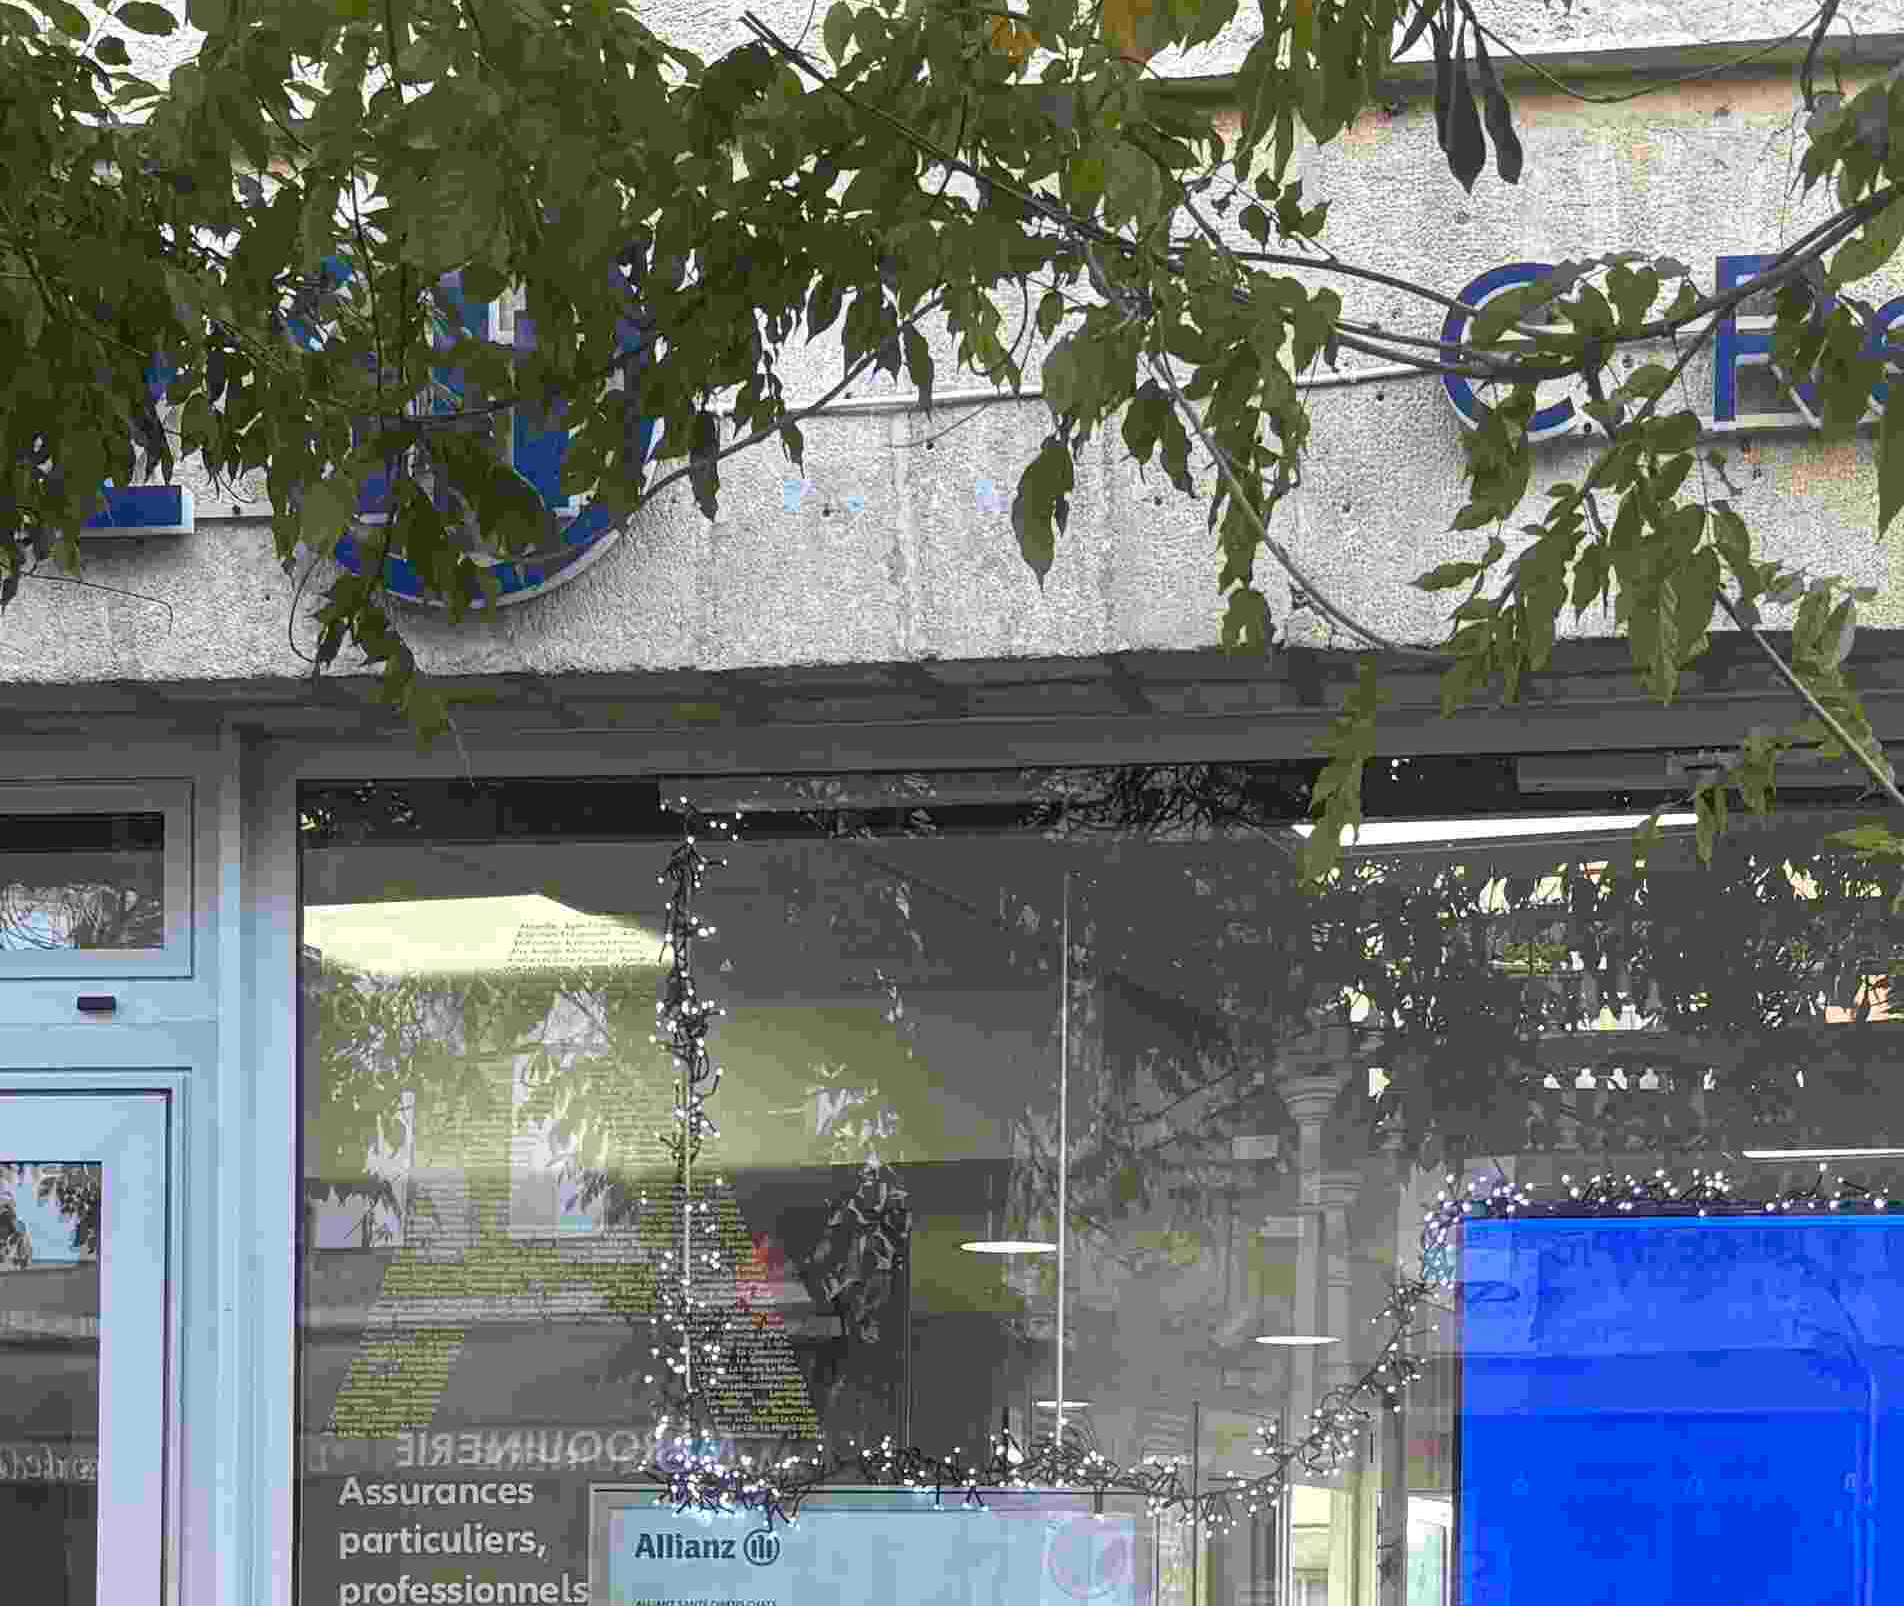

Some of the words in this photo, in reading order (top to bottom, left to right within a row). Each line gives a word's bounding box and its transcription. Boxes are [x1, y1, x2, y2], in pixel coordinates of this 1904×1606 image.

[338, 1476, 536, 1506] Assurances
[338, 1522, 549, 1565] particuliers,
[633, 1531, 737, 1562] Allianz
